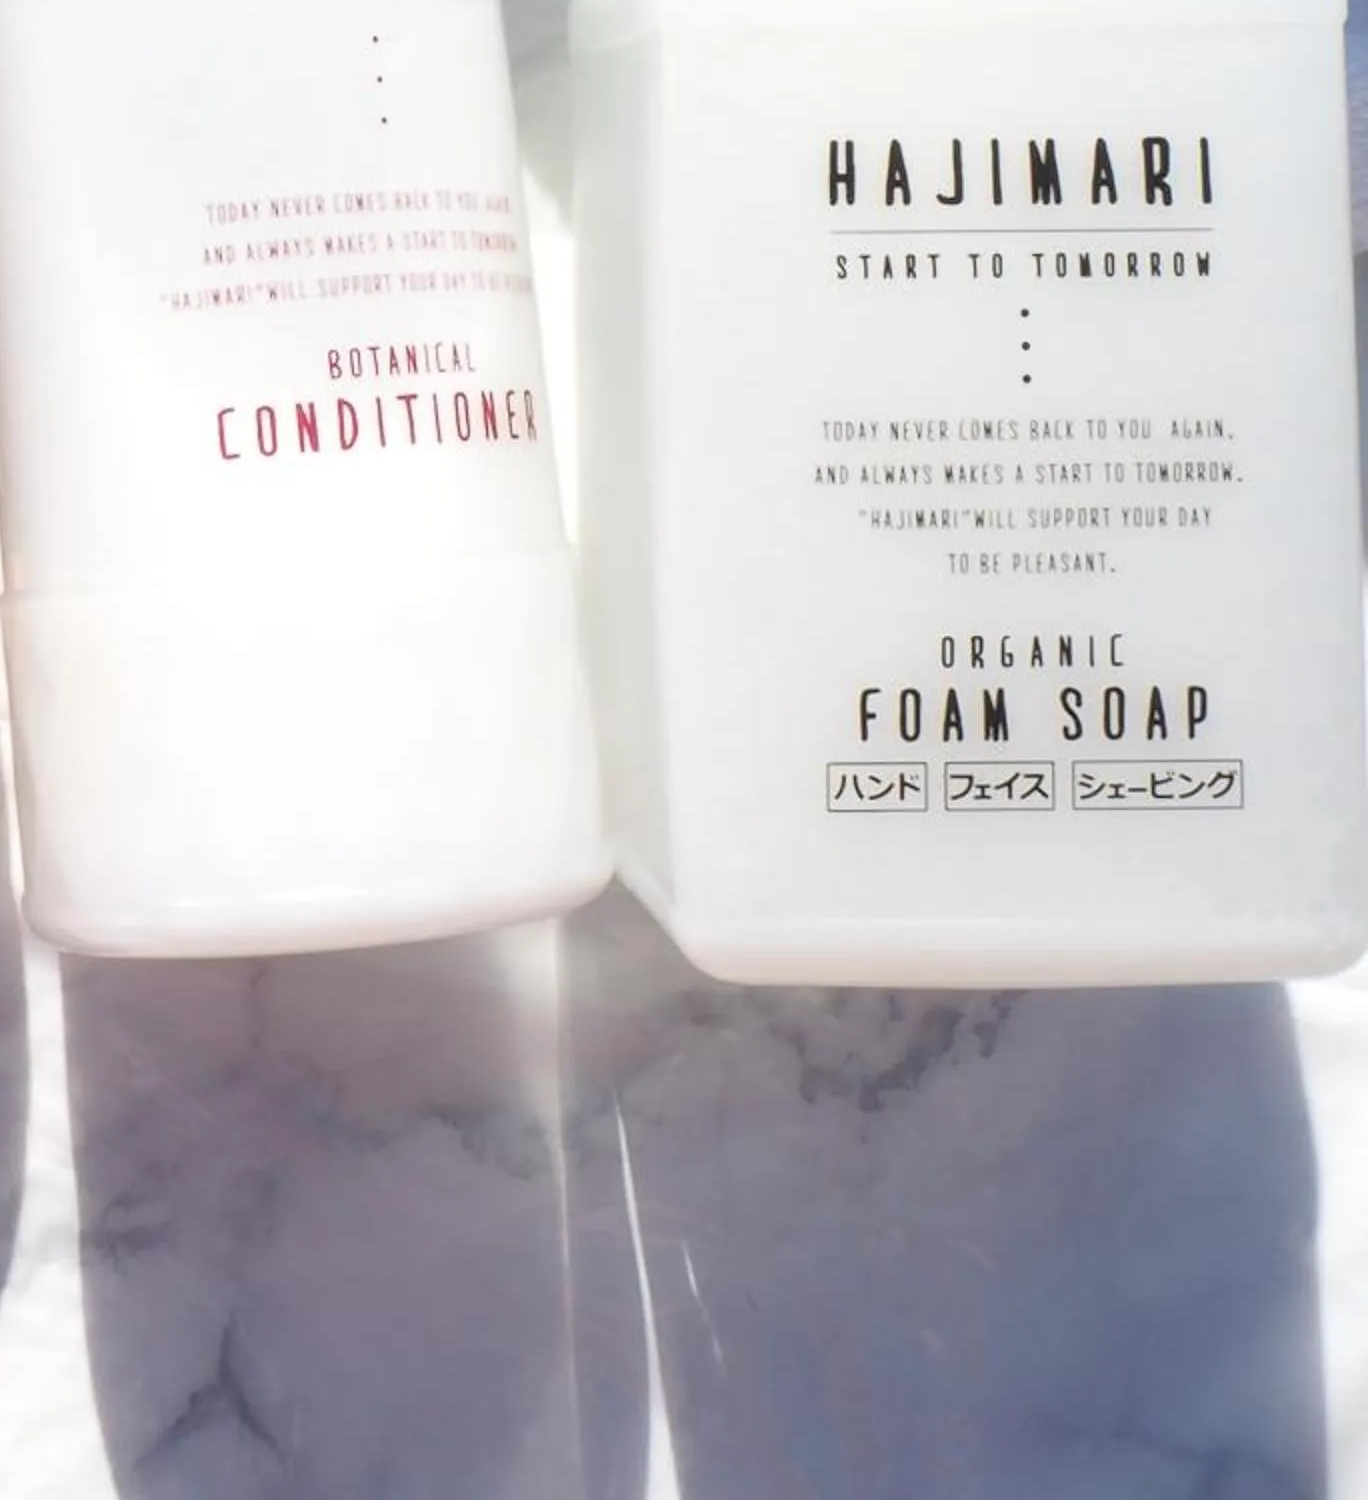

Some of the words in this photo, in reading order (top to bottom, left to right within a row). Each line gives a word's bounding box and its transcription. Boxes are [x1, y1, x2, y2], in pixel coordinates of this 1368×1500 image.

[829, 137, 1213, 207] HAJIMARI
[205, 202, 261, 225] TODAY
[270, 195, 325, 218] NEVER
[334, 192, 386, 213] COMES
[203, 244, 235, 264] AND
[247, 238, 314, 260] ALWAYS
[324, 231, 377, 255] MAKES
[387, 232, 393, 249] A
[836, 253, 941, 280] START
[969, 253, 1003, 279] TO
[1031, 251, 1212, 278] TOMORROW
[319, 274, 391, 297] SUPPORT
[327, 342, 476, 379] BOTANICAL
[217, 390, 537, 460] CONDITIONER
[823, 420, 877, 441] TODAY
[890, 420, 949, 441] NEVER
[959, 419, 1019, 441] COMES
[1029, 419, 1075, 440] BACK
[1086, 419, 1107, 439] TO
[1118, 419, 1151, 439] YOU
[814, 465, 849, 485] AND
[861, 464, 932, 485] ALWAYS
[945, 463, 1003, 485] MAKES
[1015, 463, 1024, 484] A
[1035, 462, 1093, 484] START
[1104, 462, 1125, 483] TO
[1136, 461, 1244, 483] TOMORROW.
[1027, 507, 1110, 529] SUPPORT
[1121, 506, 1168, 528] YOUR
[1178, 506, 1211, 527] DAY
[948, 553, 969, 574] TO
[980, 553, 999, 574] BE
[1013, 552, 1116, 573] PLEASANT.
[940, 634, 1127, 669] ORGANIC
[858, 686, 1009, 743] FOAM
[1061, 685, 1209, 741] SOAP
[833, 771, 922, 802] ハンド
[949, 770, 1050, 802] フェイス
[1077, 769, 1236, 800] シェービング
